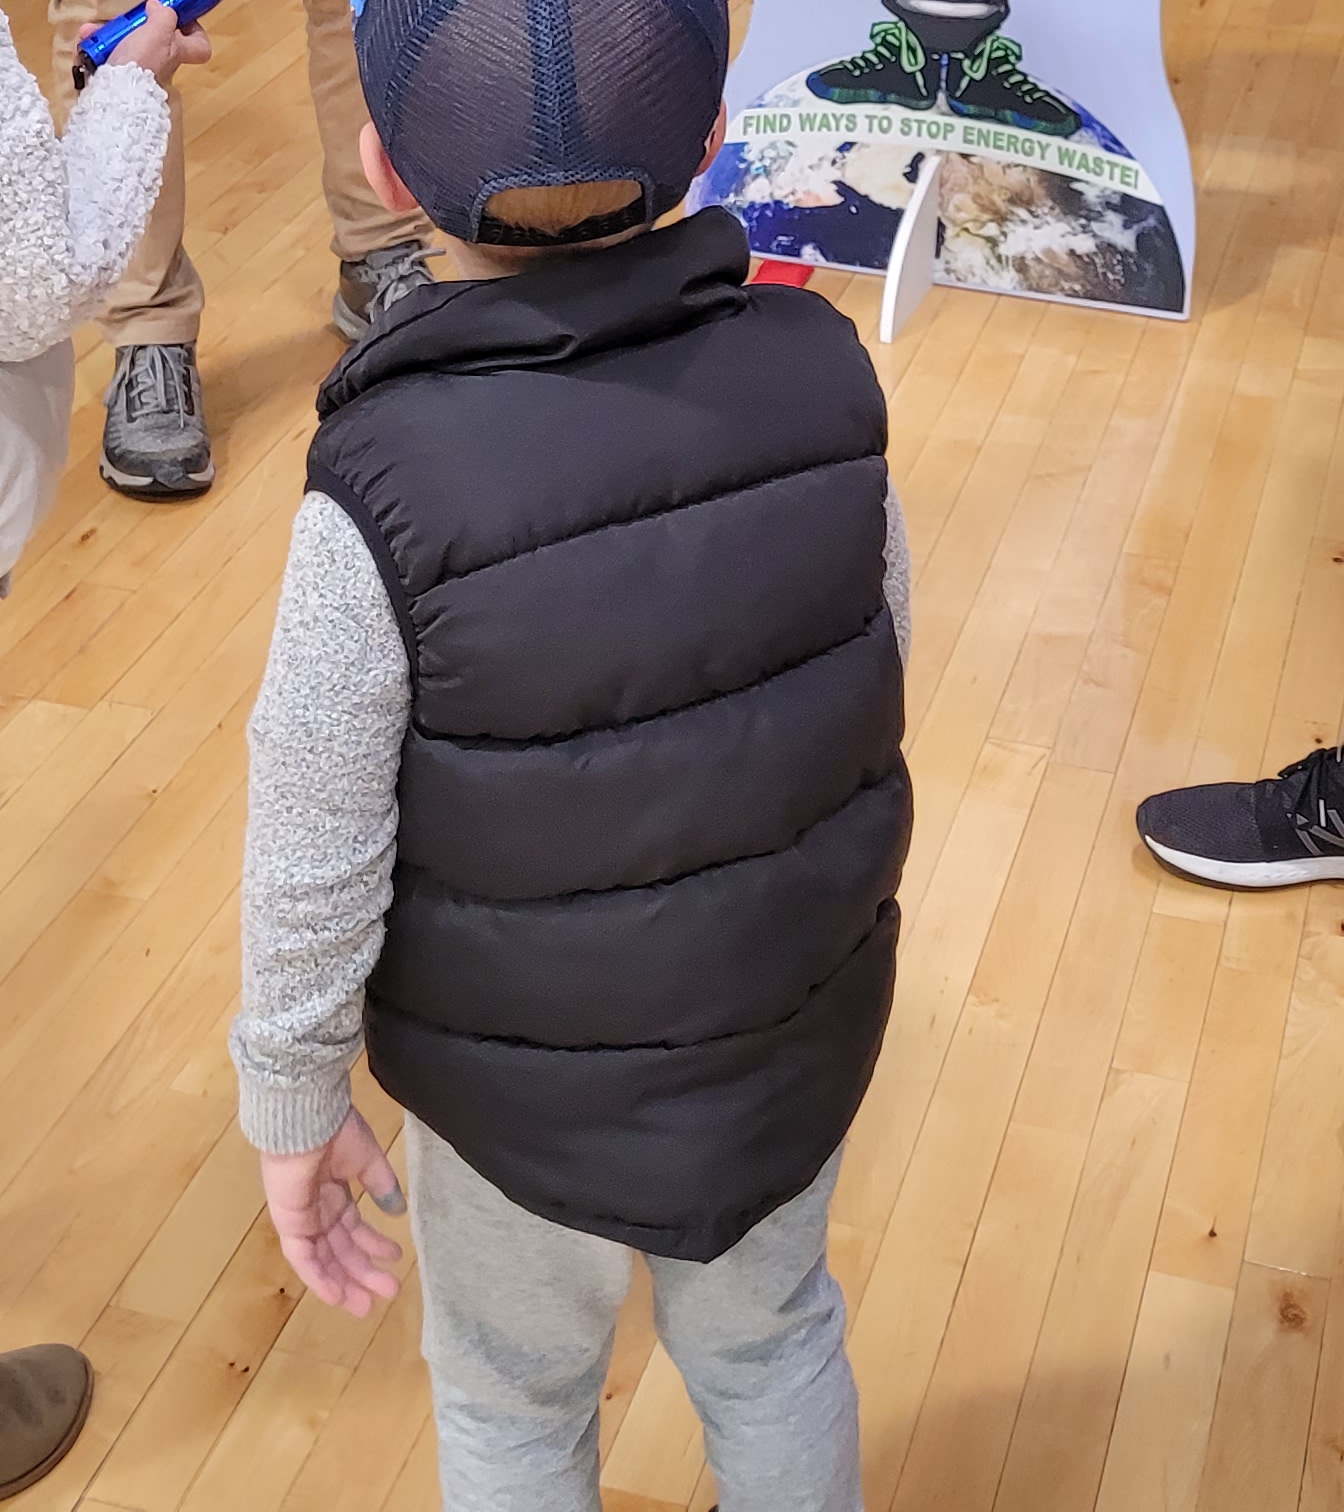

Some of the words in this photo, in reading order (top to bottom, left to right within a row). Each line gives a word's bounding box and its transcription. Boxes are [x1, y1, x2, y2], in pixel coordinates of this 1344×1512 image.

[742, 113, 792, 136] FIND
[798, 112, 857, 133] WAYS
[865, 114, 894, 135] TO
[899, 117, 955, 142] STOP
[962, 125, 1052, 161] ENERGY
